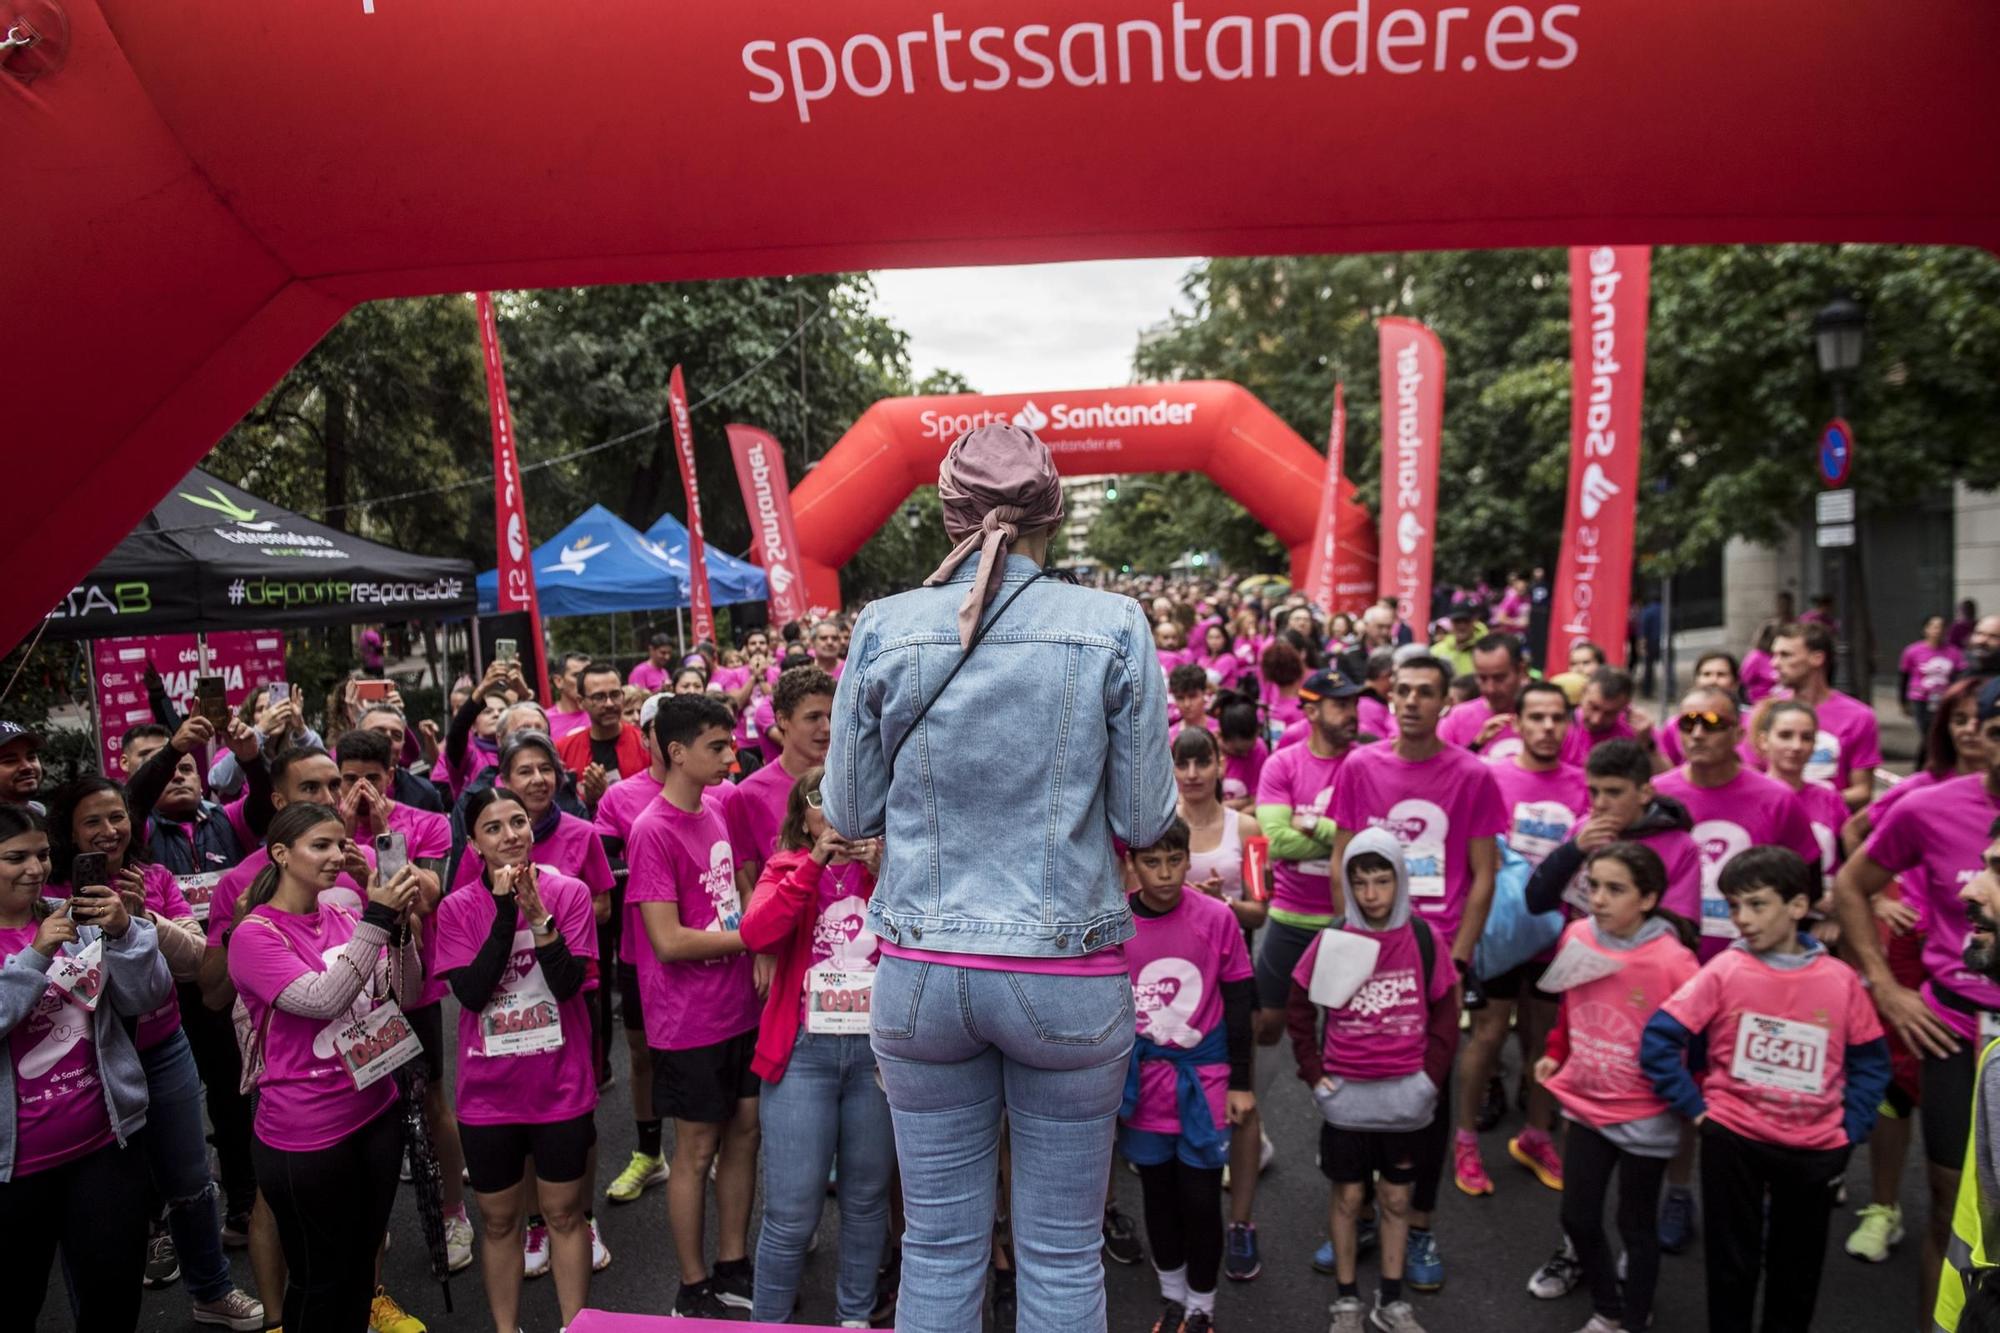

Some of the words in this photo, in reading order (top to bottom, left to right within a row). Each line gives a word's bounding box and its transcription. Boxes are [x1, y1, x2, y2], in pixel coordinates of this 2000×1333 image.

[742, 0, 1581, 123] sportssantander.es
[1051, 399, 1198, 430] Santander
[228, 575, 463, 610] #deporteresponsable
[1748, 1035, 1813, 1072] 6641
